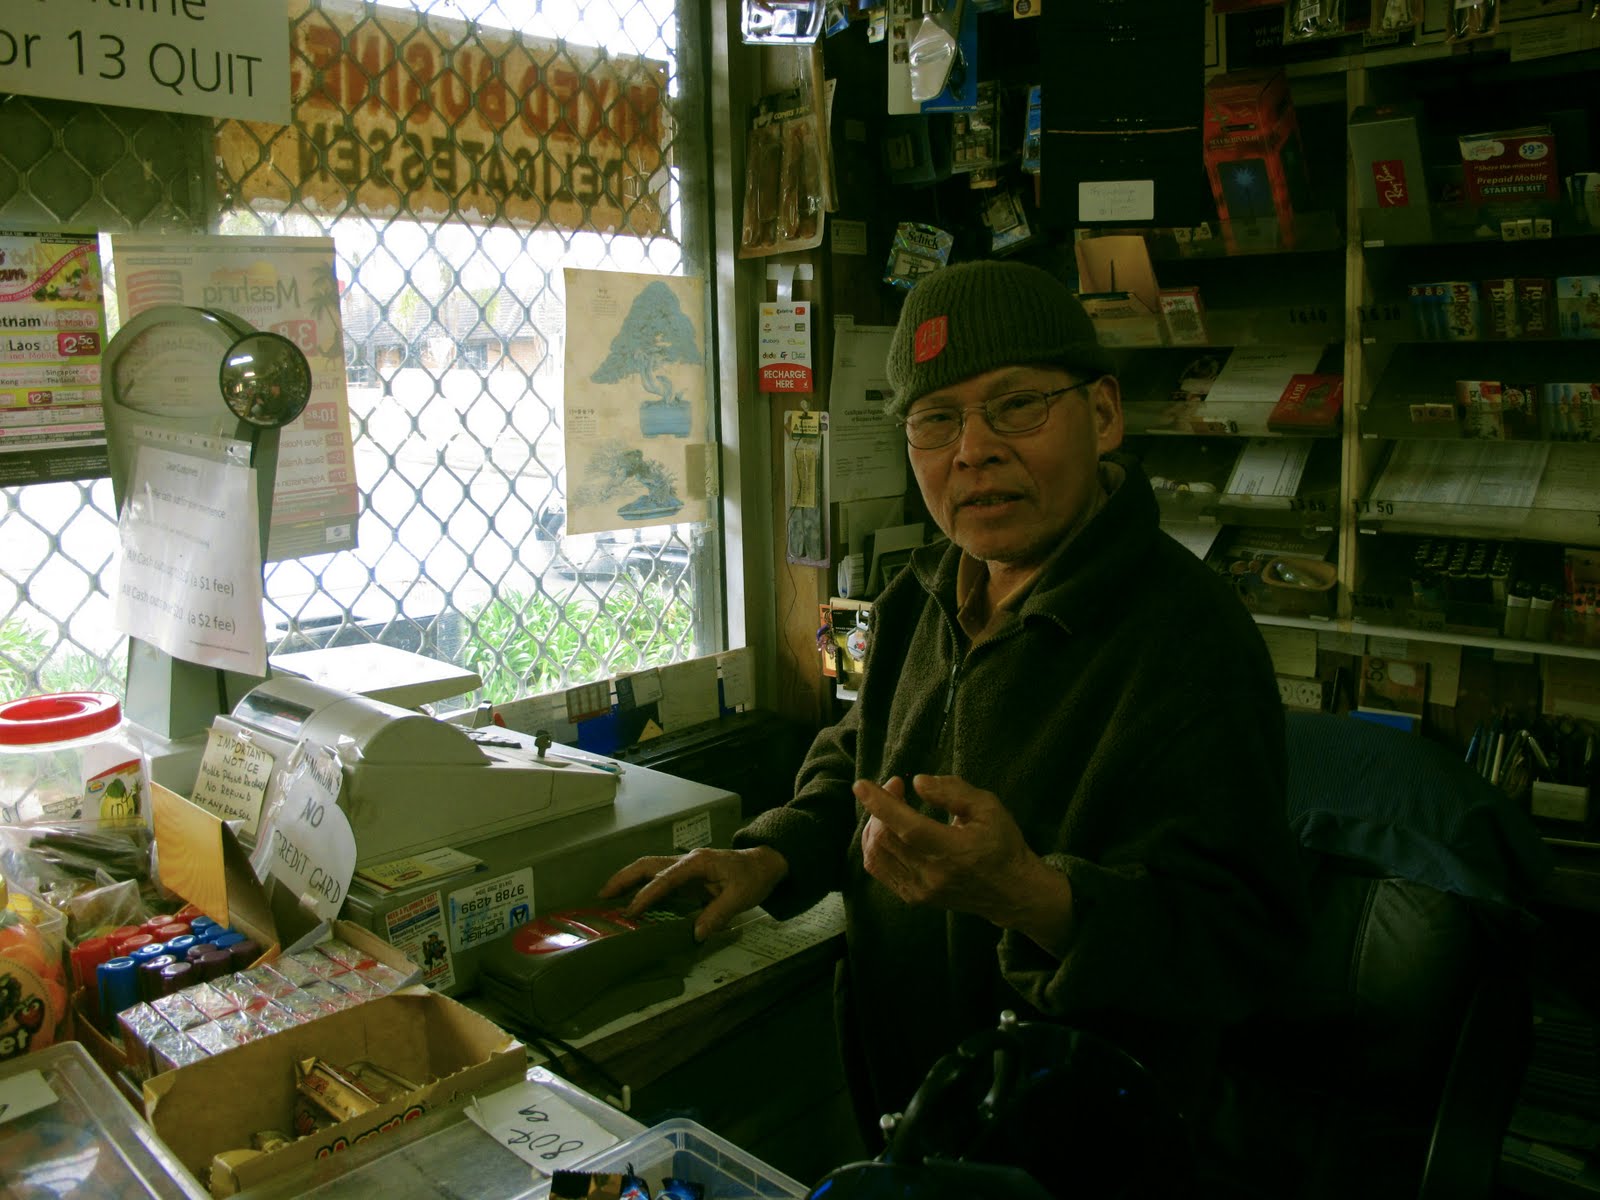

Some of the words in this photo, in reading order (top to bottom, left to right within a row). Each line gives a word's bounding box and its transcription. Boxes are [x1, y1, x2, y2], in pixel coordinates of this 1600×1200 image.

[68, 30, 126, 80] 13
[149, 43, 262, 97] QUIT
[1477, 175, 1513, 185] Prepaid
[1514, 173, 1548, 183] Mobile
[1483, 185, 1524, 194] STARTER
[1526, 184, 1542, 192] KIT
[907, 231, 938, 249] Schick
[9, 339, 40, 351] Laos
[46, 369, 80, 378] Singapore
[47, 377, 76, 385] Thailand
[764, 370, 806, 379] RECHARGE
[776, 380, 794, 388] HERE
[200, 575, 210, 591] $1
[213, 579, 234, 598] fee)
[132, 587, 149, 602] Cash
[199, 612, 211, 629] $2
[213, 615, 236, 635] fee)
[217, 735, 267, 762] IMPORTANT
[223, 755, 259, 774] NOTICE
[301, 797, 325, 828] NO
[275, 830, 310, 875] CREDIT
[309, 868, 341, 904] CARD
[495, 884, 525, 903] 9788
[461, 896, 492, 914] 4299
[460, 923, 505, 945] UPHIGH
